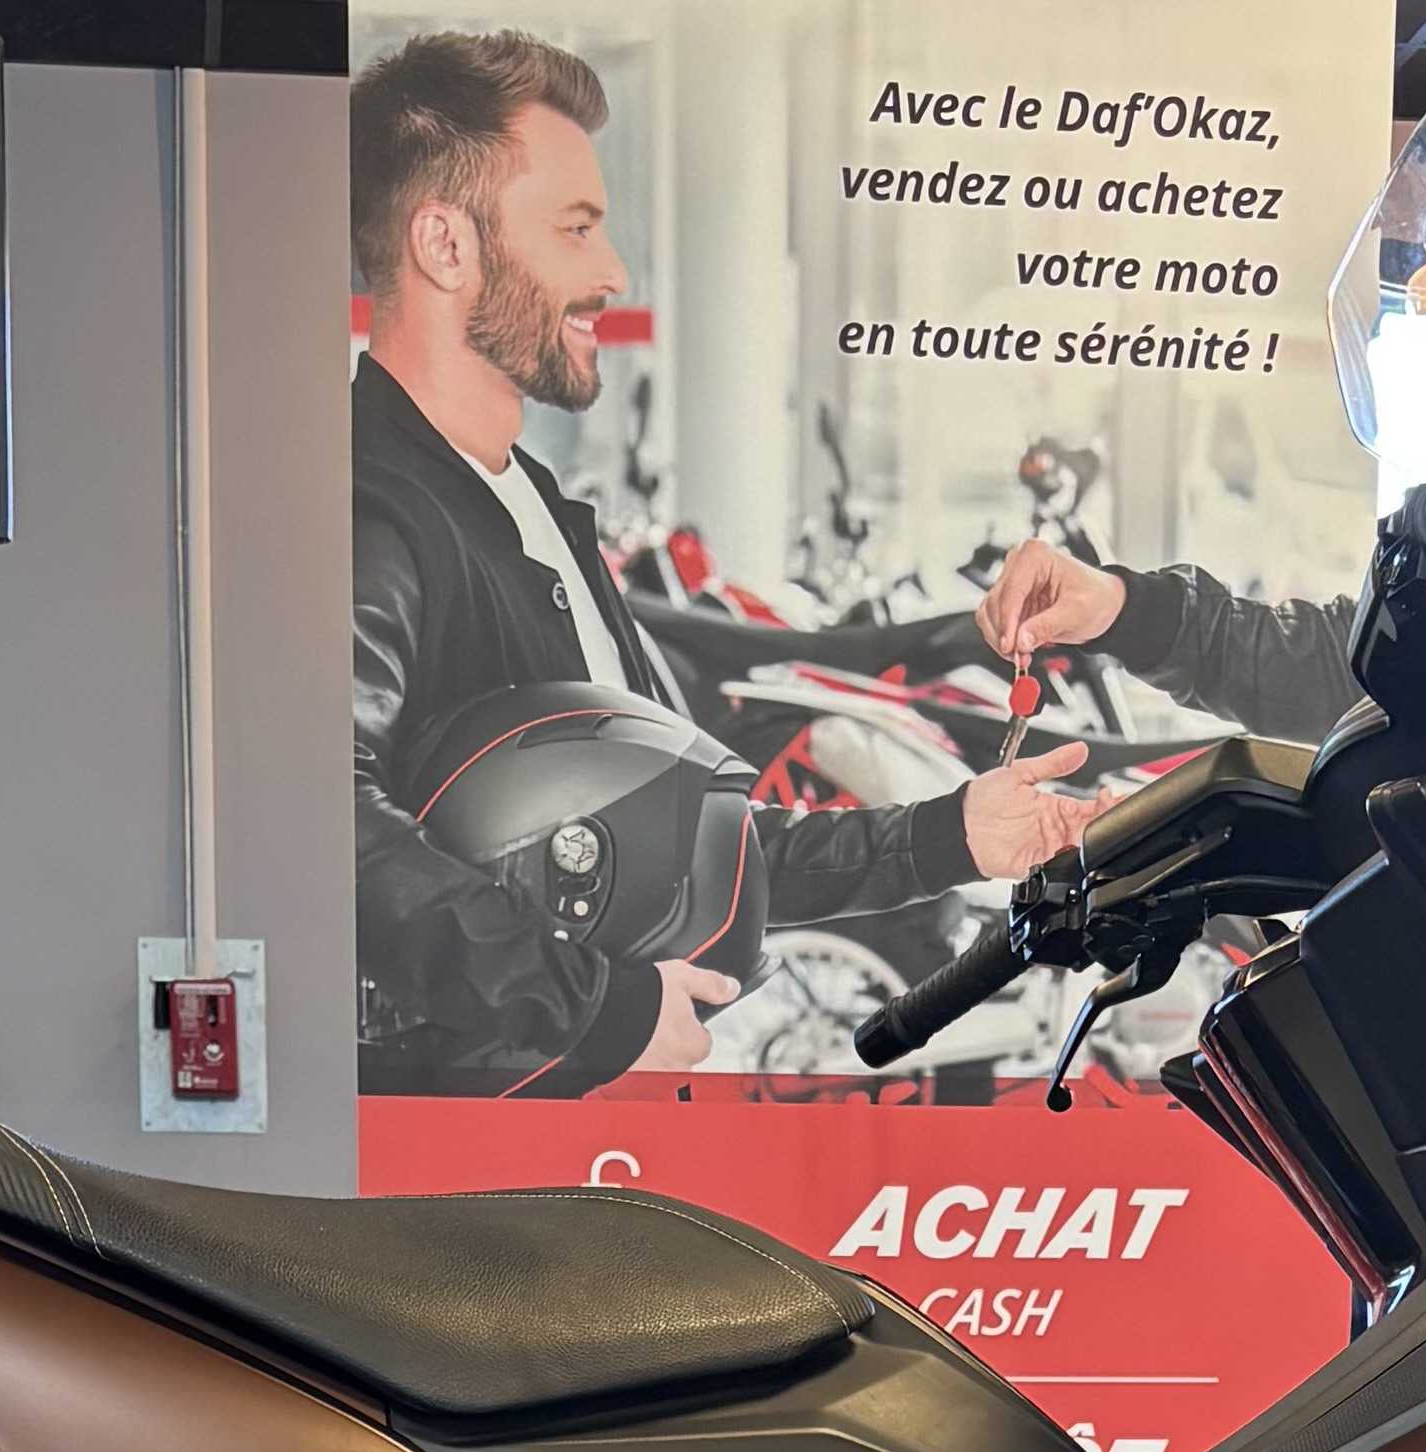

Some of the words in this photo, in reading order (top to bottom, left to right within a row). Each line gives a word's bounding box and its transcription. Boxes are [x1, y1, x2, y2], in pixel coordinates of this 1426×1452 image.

[870, 82, 986, 126] Avec
[999, 86, 1042, 130] le
[1057, 91, 1280, 149] Daf'Okaz,
[842, 161, 1011, 206] vendez
[1024, 175, 1083, 209] ou
[1098, 172, 1283, 220] achetez
[1017, 250, 1141, 289] votre
[1155, 256, 1279, 297] moto
[838, 320, 895, 355] en
[911, 319, 1041, 362] toute
[1054, 322, 1250, 372] sérénité
[1262, 333, 1280, 374] !
[829, 1185, 1189, 1259] ACHAT
